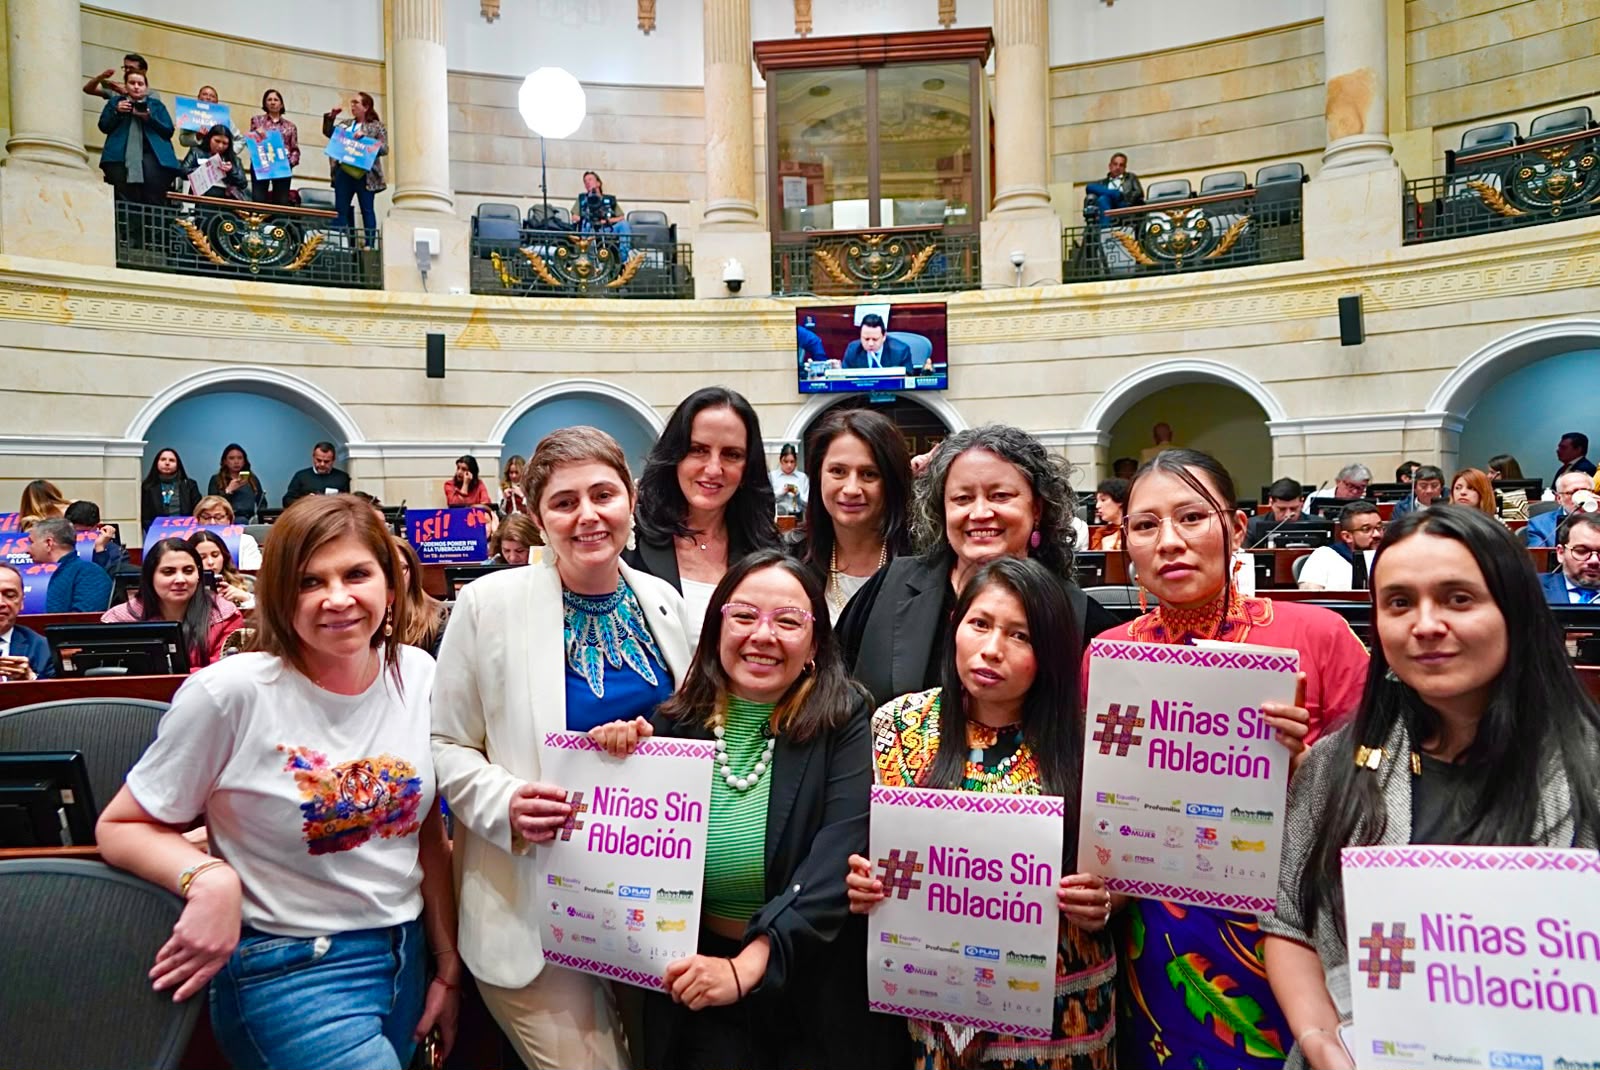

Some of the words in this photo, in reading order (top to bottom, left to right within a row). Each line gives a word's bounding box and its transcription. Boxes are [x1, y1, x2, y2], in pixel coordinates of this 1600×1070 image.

[415, 510, 451, 543] ¡SÍ!
[1150, 699, 1230, 736] Niñas
[1147, 738, 1271, 780] Ablación
[591, 786, 658, 820] Niñas
[664, 791, 703, 823] Sin
[1096, 791, 1116, 805] EN
[1144, 802, 1181, 813] Profamilia
[1201, 806, 1223, 814] PLAN
[587, 822, 692, 860] Ablación
[1130, 829, 1156, 839] MUJER
[928, 845, 1004, 883] Niñas
[1010, 852, 1053, 887] Sin
[547, 874, 562, 887] EN
[584, 886, 615, 896] Profamilia
[631, 888, 651, 896] PLAN
[927, 883, 1043, 925] Ablación
[880, 932, 899, 945] EN
[1420, 912, 1527, 956] Niñas
[1536, 917, 1600, 961] Sin
[979, 949, 999, 957] PLAN
[914, 966, 938, 976] MUJER
[1427, 962, 1599, 1015] Ablación
[1372, 1039, 1395, 1056] EN
